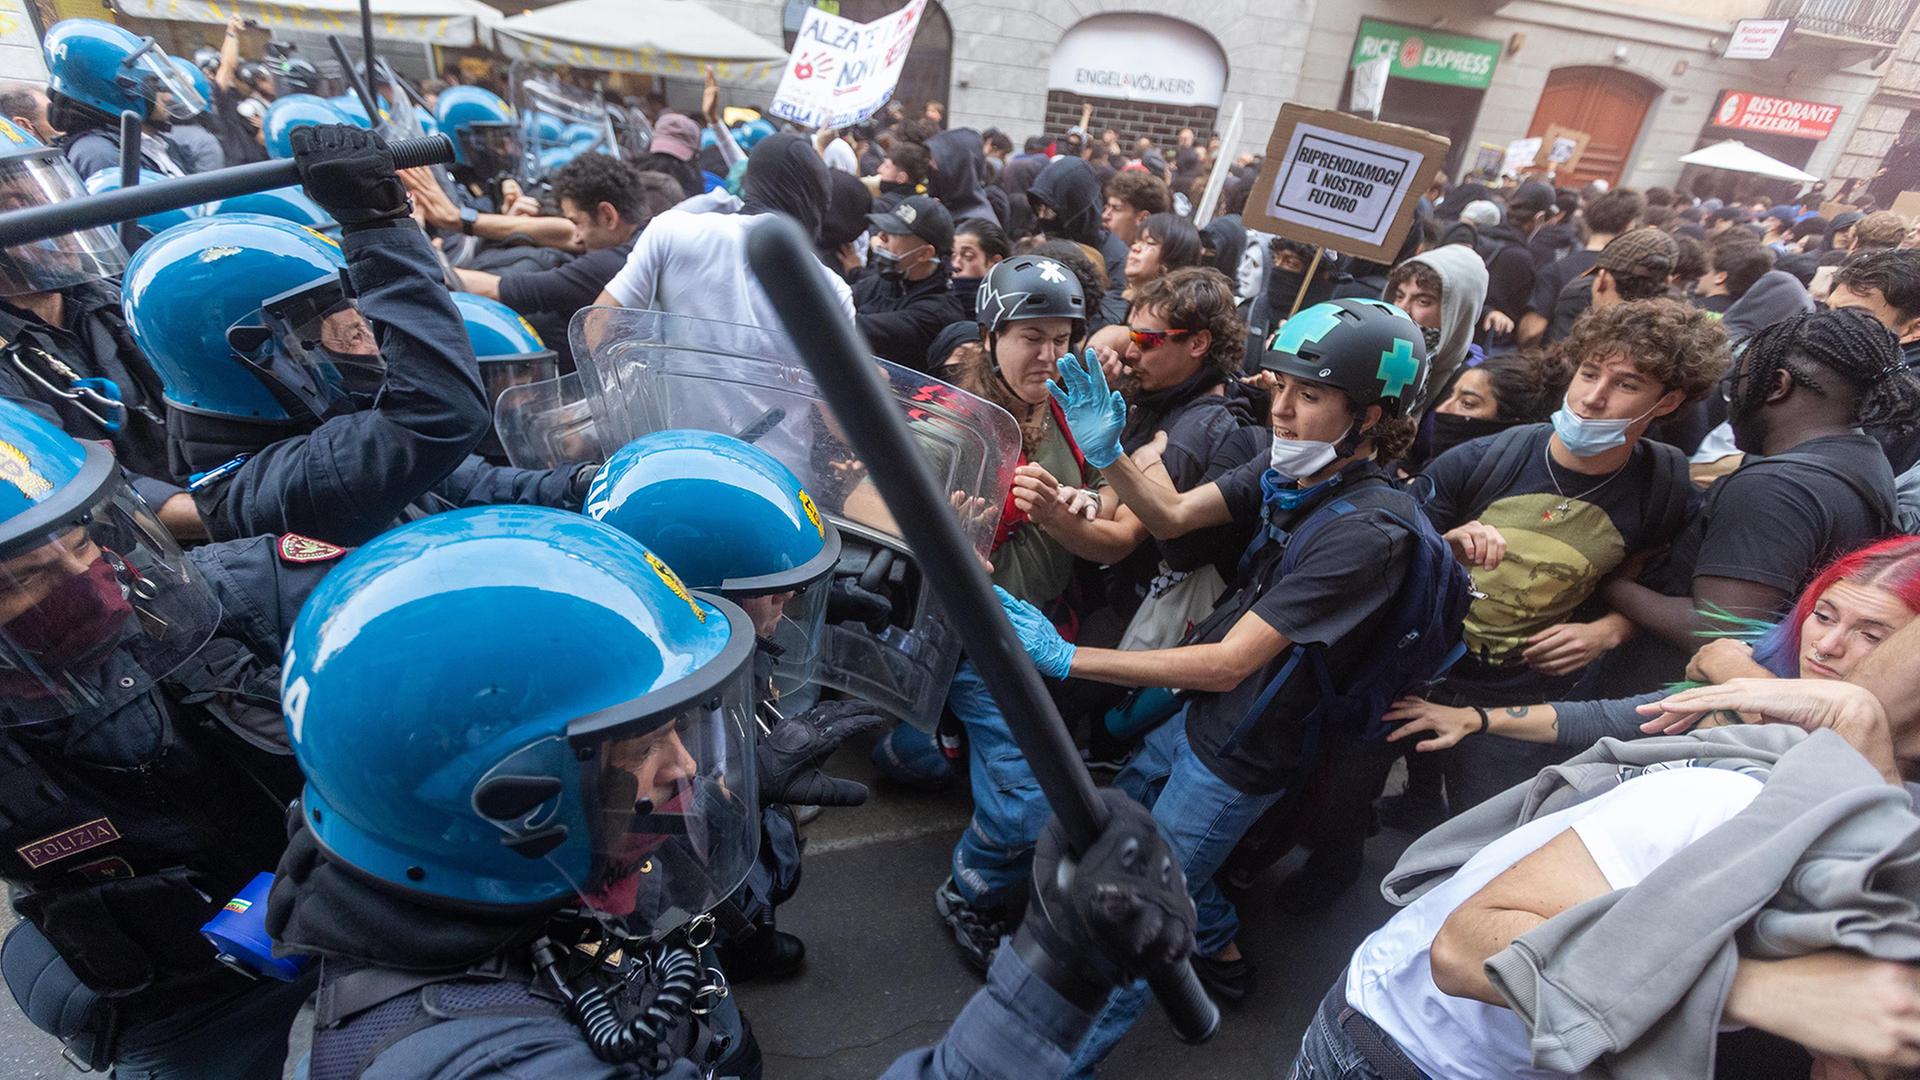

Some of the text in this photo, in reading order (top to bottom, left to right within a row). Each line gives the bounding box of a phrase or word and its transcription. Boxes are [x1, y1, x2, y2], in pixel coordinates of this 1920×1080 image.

[1360, 35, 1492, 75] RICE EXPRESS
[1740, 112, 1800, 132] PIZZERIA
[1746, 96, 1838, 123] RISTORANTE
[1298, 147, 1400, 186] RIPRENDIAMOCI
[1307, 169, 1374, 199] IL NOSTRO
[1307, 188, 1358, 213] FUTURO
[28, 825, 112, 861] POLIZIA
